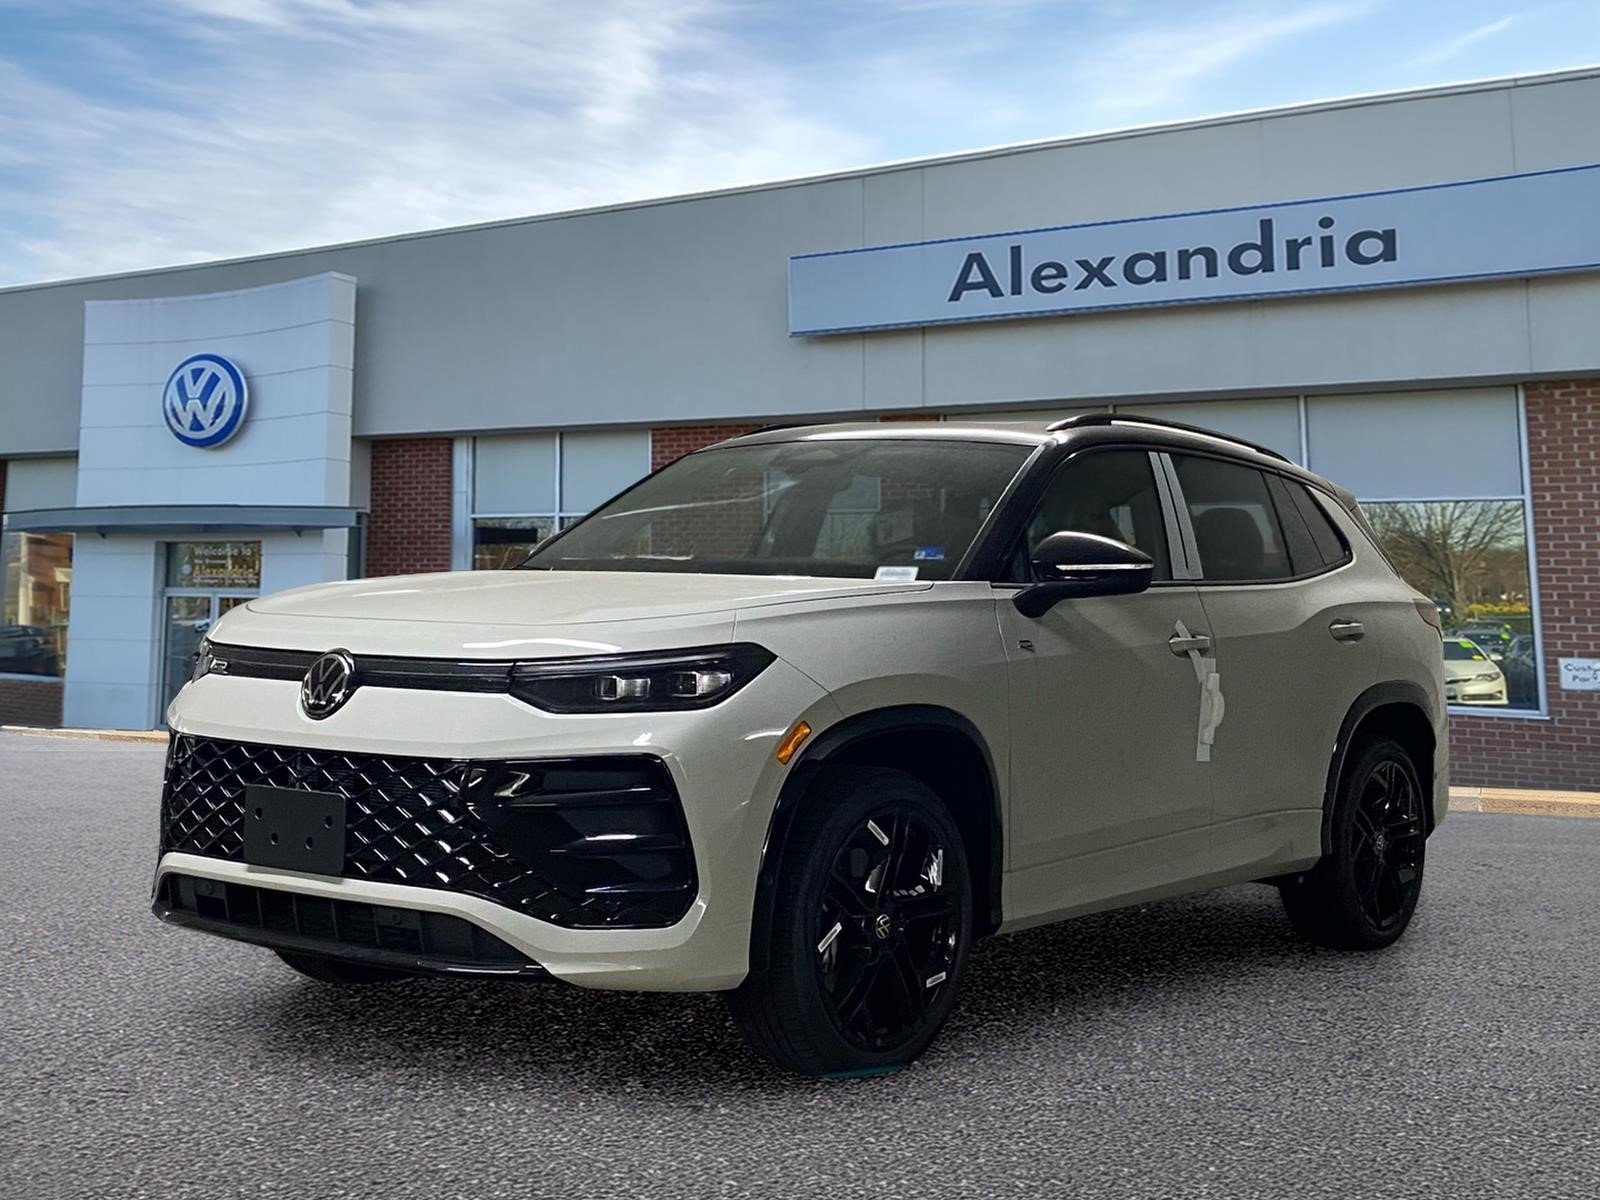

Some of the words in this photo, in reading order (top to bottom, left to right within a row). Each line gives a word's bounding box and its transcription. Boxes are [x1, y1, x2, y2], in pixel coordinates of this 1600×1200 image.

[948, 216, 1397, 302] Alexandria
[165, 360, 236, 438] VW
[303, 654, 348, 713] VW
